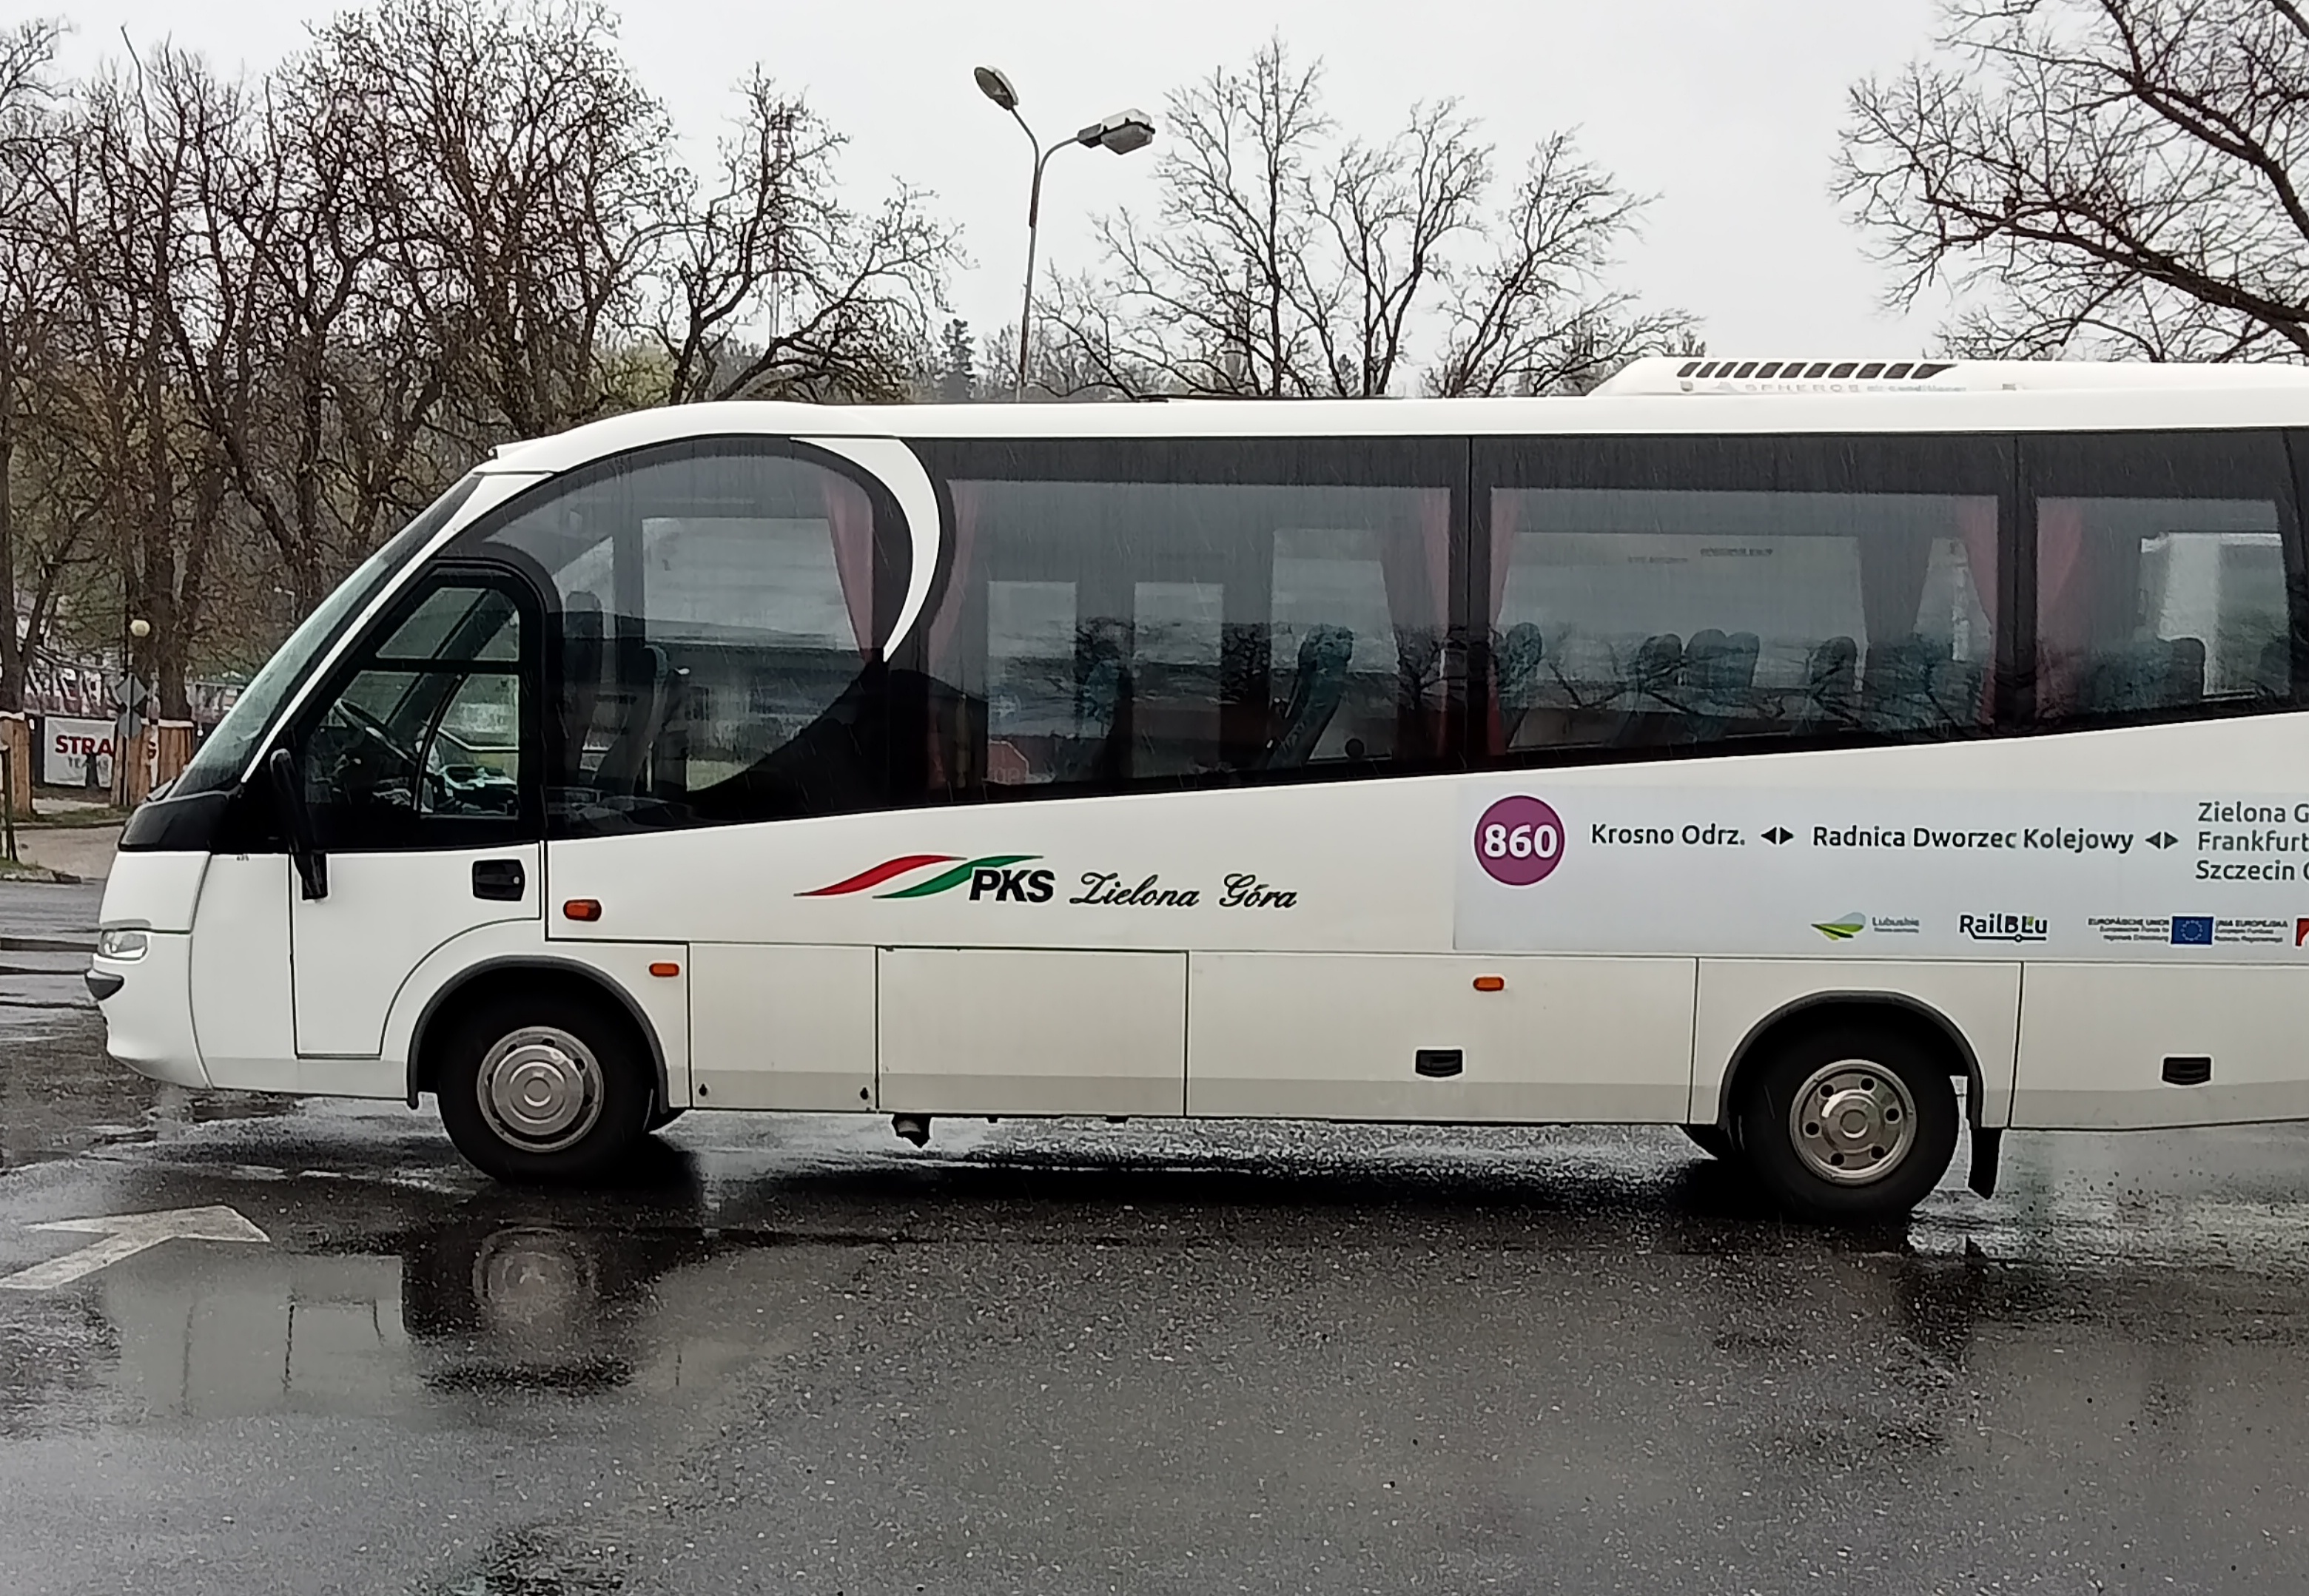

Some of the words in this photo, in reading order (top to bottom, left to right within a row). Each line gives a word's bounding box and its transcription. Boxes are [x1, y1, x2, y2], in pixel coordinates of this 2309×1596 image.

[2198, 801, 2286, 823] Zielona
[1484, 824, 1557, 858] 860
[1592, 824, 1674, 845] Krosno
[1681, 823, 1745, 846] Odrz.
[1813, 825, 1906, 848] Radnica
[1913, 827, 2017, 849] Dworzec
[2023, 826, 2134, 855] Kolejowy
[2198, 829, 2309, 852] Frankfurt
[2195, 859, 2295, 881] Szczecin
[969, 870, 1055, 903] PKS
[1069, 872, 1200, 907] Zielona
[1219, 873, 1297, 909] Góra
